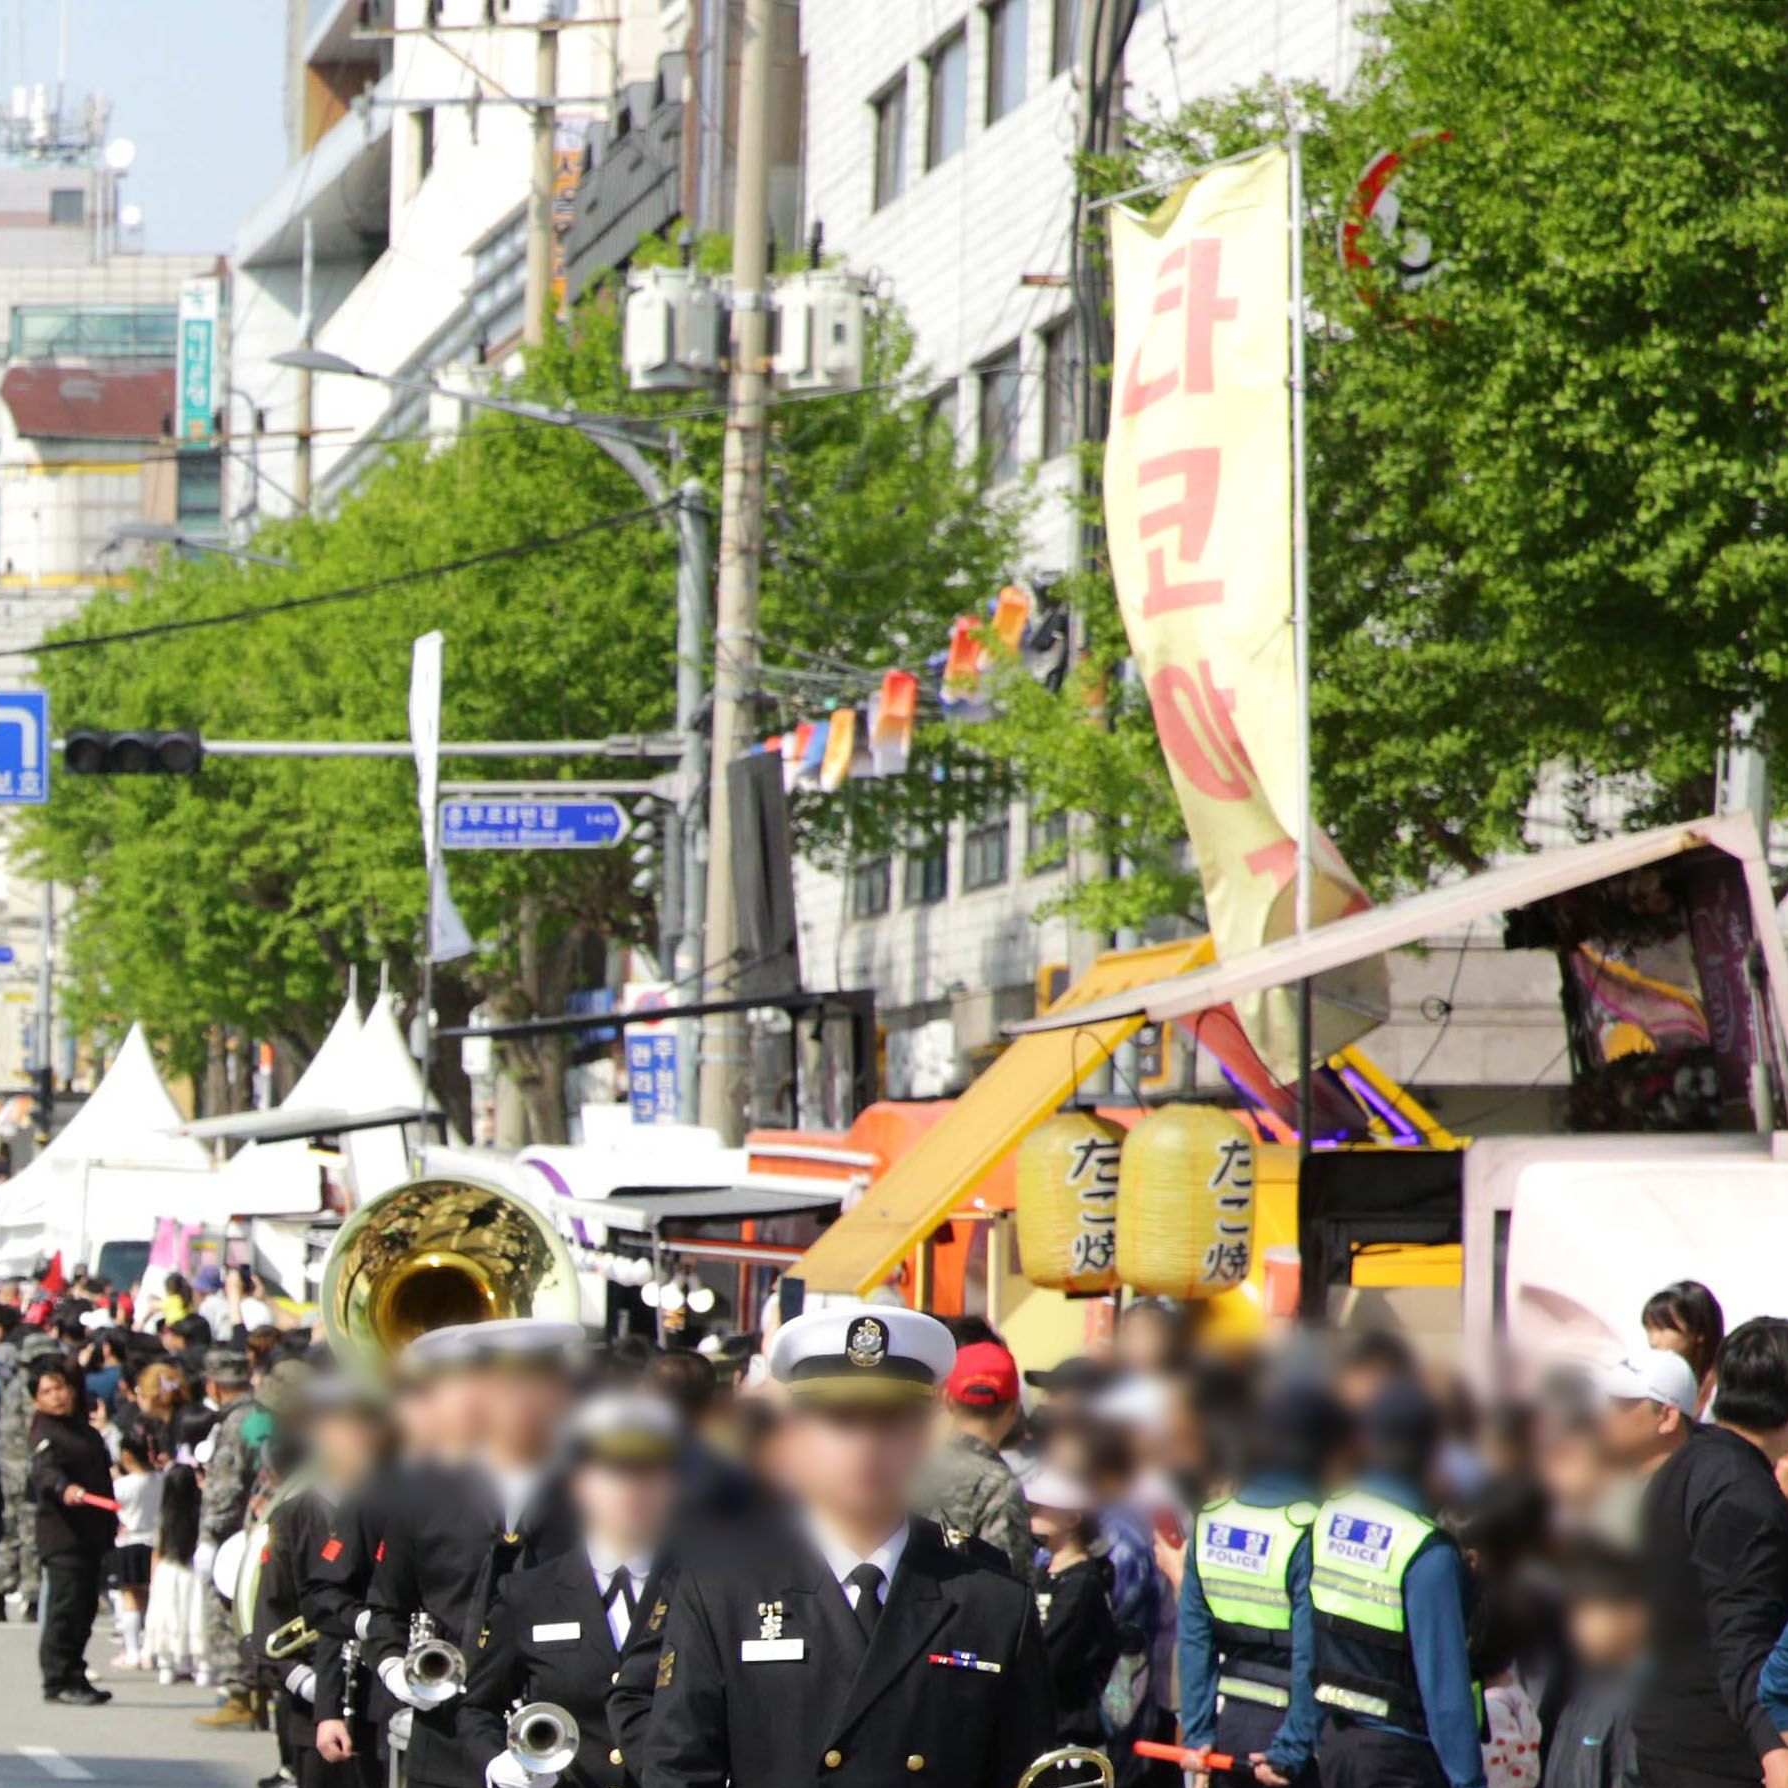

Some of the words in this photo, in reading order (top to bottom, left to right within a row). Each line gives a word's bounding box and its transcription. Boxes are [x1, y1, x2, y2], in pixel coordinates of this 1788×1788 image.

[1122, 238, 1300, 893] 타코야
[1204, 1139, 1253, 1283] たこ焼
[1206, 1547, 1260, 1570] POLICE
[1328, 1540, 1379, 1564] POLICE
